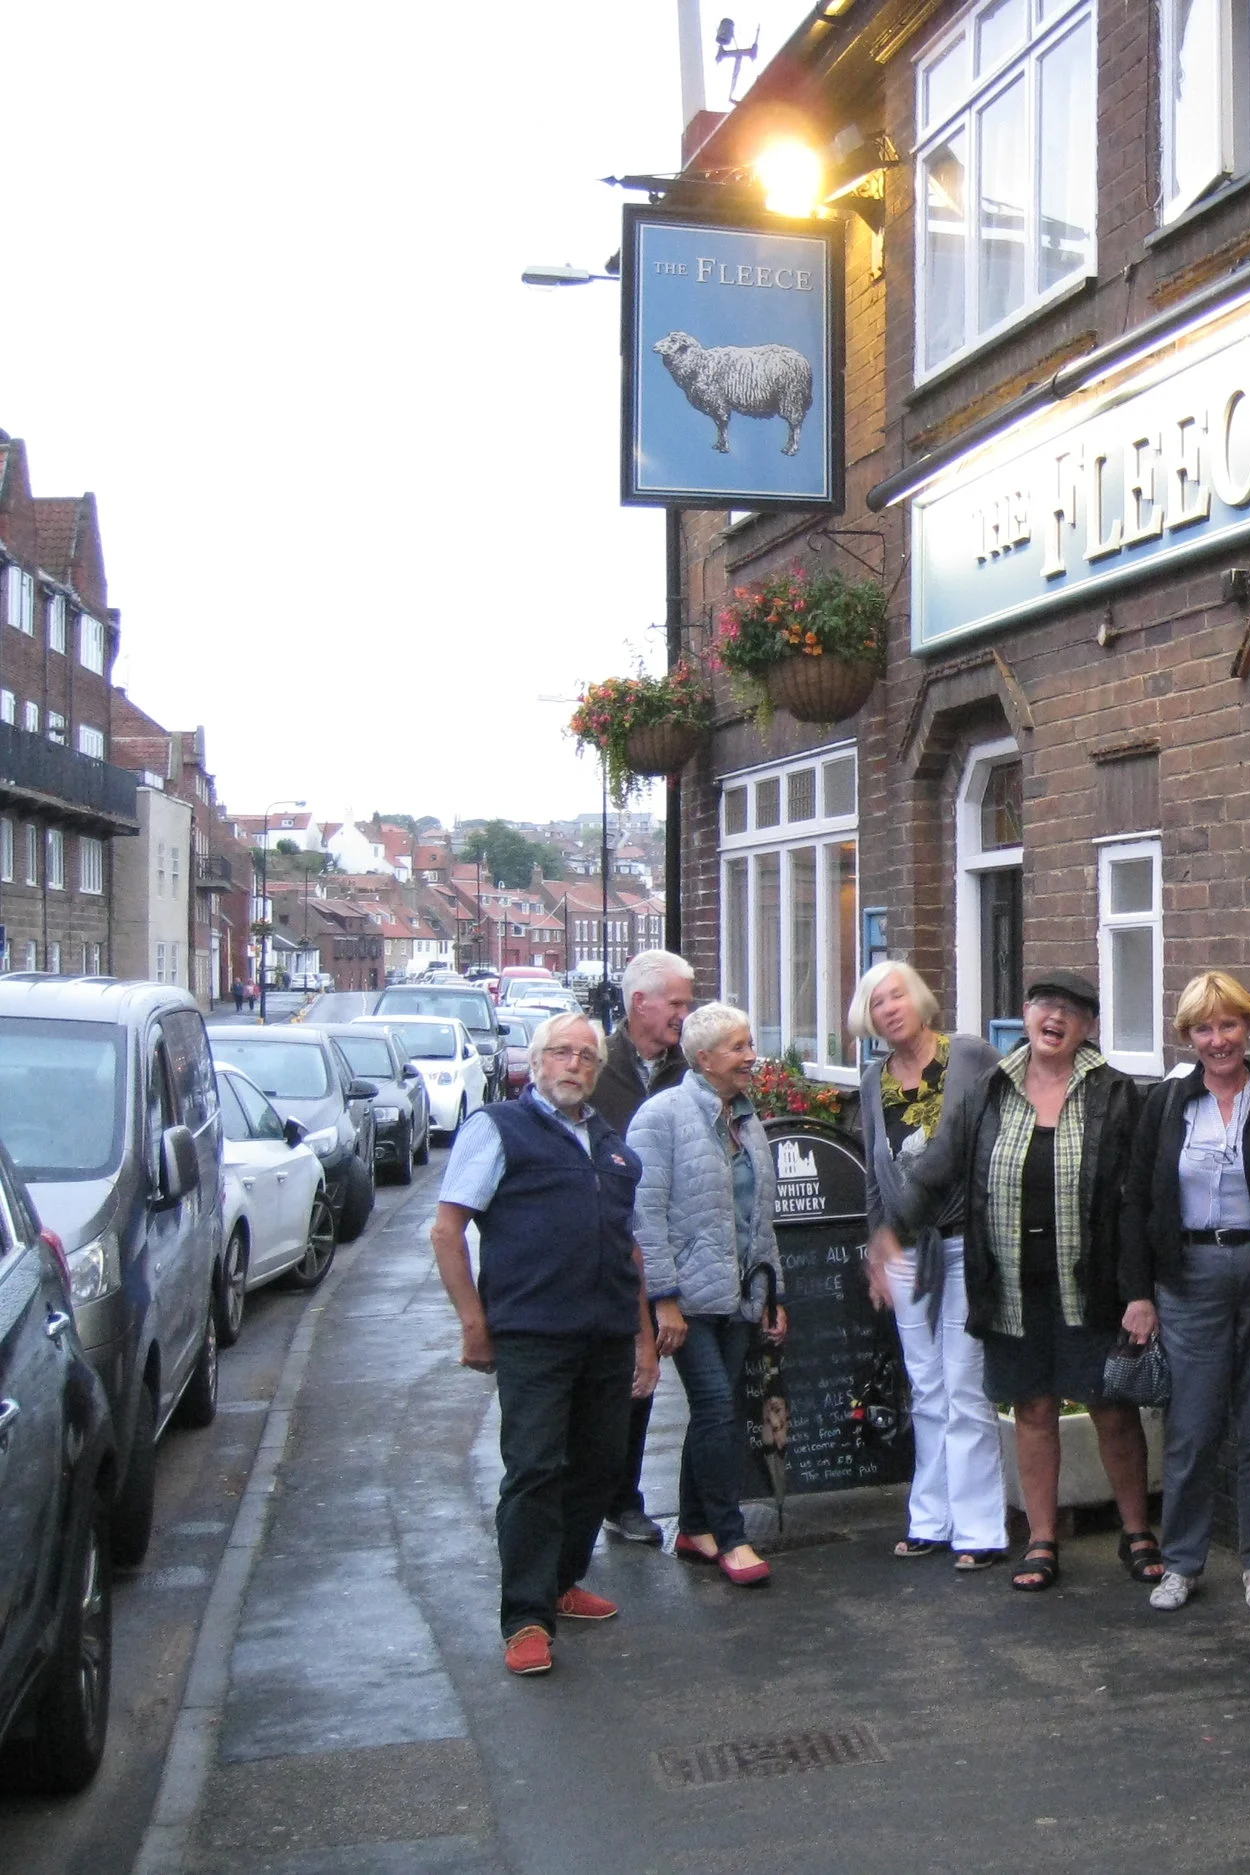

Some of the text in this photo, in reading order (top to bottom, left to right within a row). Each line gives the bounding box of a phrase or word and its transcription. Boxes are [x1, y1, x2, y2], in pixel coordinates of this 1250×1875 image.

[653, 257, 814, 291] THE FLEECE
[972, 489, 1032, 566] THE
[777, 1182, 820, 1197] WHITBY
[774, 1197, 826, 1213] BREWERY
